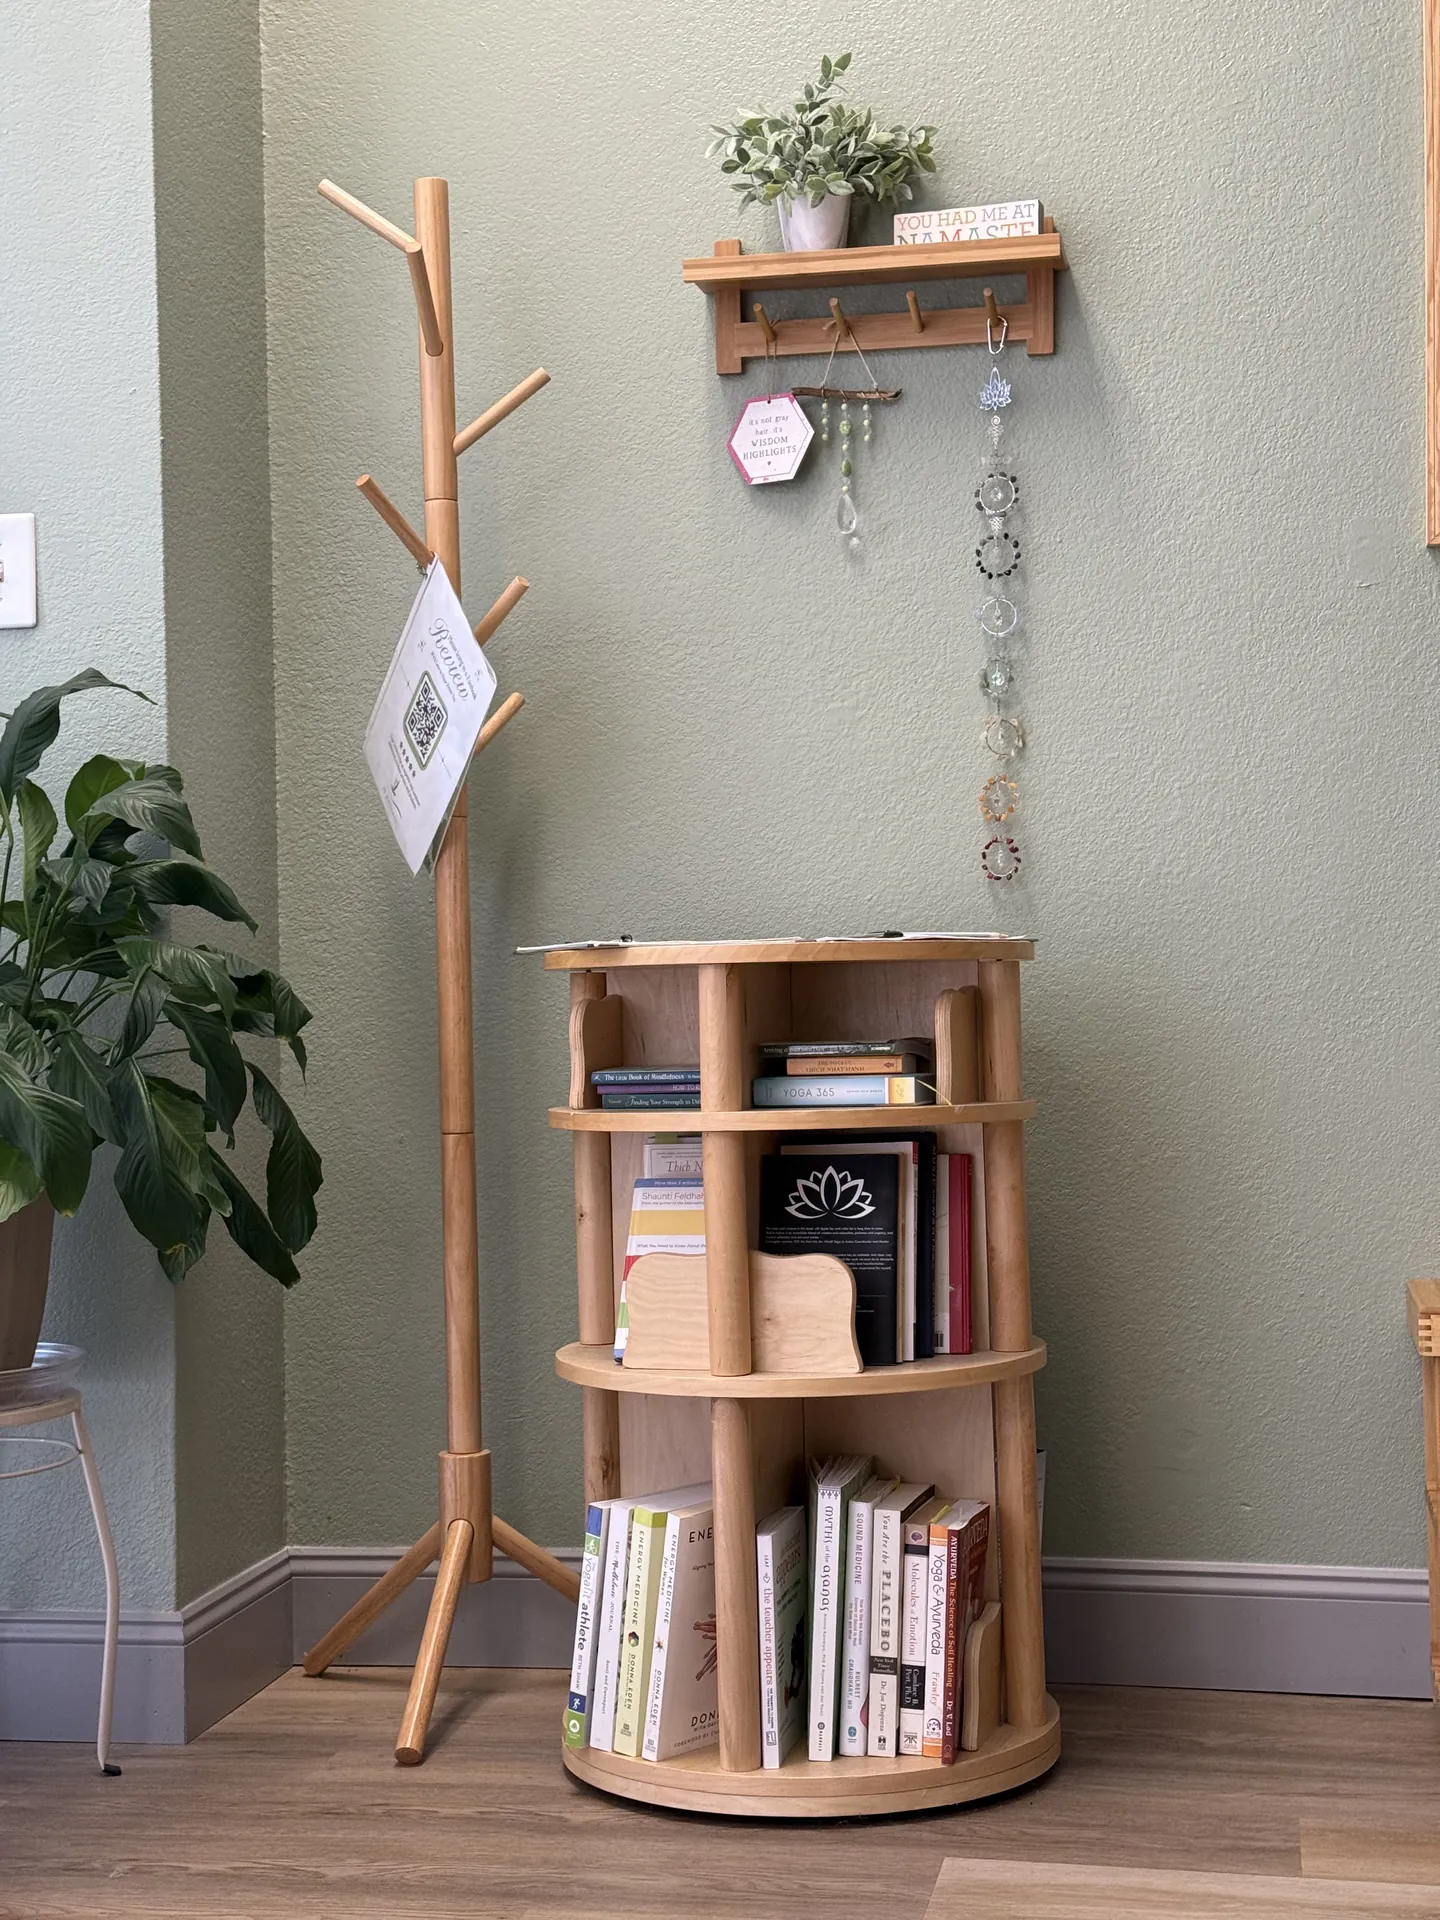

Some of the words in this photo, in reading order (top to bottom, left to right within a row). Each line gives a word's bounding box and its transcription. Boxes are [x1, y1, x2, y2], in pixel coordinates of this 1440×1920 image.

[897, 215, 932, 231] YOU
[937, 211, 976, 227] HAD
[982, 207, 1007, 222] ME
[1012, 204, 1035, 219] AT
[755, 428, 768, 436] hair
[760, 416, 772, 424] not
[775, 415, 789, 424] gray
[743, 445, 797, 460] HIGHLIGHTS
[751, 436, 788, 447] WISDOM
[429, 618, 468, 701] Review
[783, 1088, 813, 1098] YOGA
[816, 1087, 835, 1098] 365
[666, 1160, 691, 1172] Thich
[642, 1192, 672, 1200] Shaunti
[824, 1506, 833, 1544] MYTHS
[856, 1513, 864, 1541] SOUND
[881, 1514, 891, 1531] You
[636, 1530, 645, 1571] ENERGY
[668, 1534, 678, 1573] ENERGY
[882, 1532, 890, 1548] Are
[854, 1544, 863, 1585] MEDICINE
[882, 1551, 890, 1565] the
[931, 1553, 945, 1582] Yoga
[950, 1535, 958, 1580] AYURVEDA
[763, 1588, 772, 1604] the
[820, 1565, 831, 1611] asanas
[910, 1562, 920, 1608] Molecules
[933, 1583, 944, 1596] &
[949, 1581, 957, 1595] The
[631, 1574, 641, 1625] MEDICINE
[663, 1576, 673, 1625] MEDICINE
[881, 1570, 891, 1653] PLACEBO
[948, 1598, 956, 1627] Science
[578, 1602, 591, 1651] athlete
[763, 1606, 773, 1643] teacher
[909, 1616, 919, 1656] Emotion
[931, 1598, 944, 1655] Ayurveda
[948, 1629, 956, 1638] of
[948, 1639, 956, 1655] Self
[628, 1653, 636, 1684] DONNA
[763, 1646, 774, 1685] appears
[904, 1668, 912, 1684] Pert,
[946, 1657, 955, 1688] Healing
[574, 1672, 582, 1690] SHAW
[653, 1670, 662, 1700] DONNA
[904, 1686, 912, 1704] Ph.D.
[911, 1669, 920, 1697] Candace
[929, 1671, 940, 1706] Frawley
[626, 1687, 634, 1710] EDEN
[879, 1691, 887, 1702] Joe
[651, 1703, 659, 1726] EDEN
[878, 1704, 886, 1732] Dispenza
[945, 1721, 953, 1736] Lad
